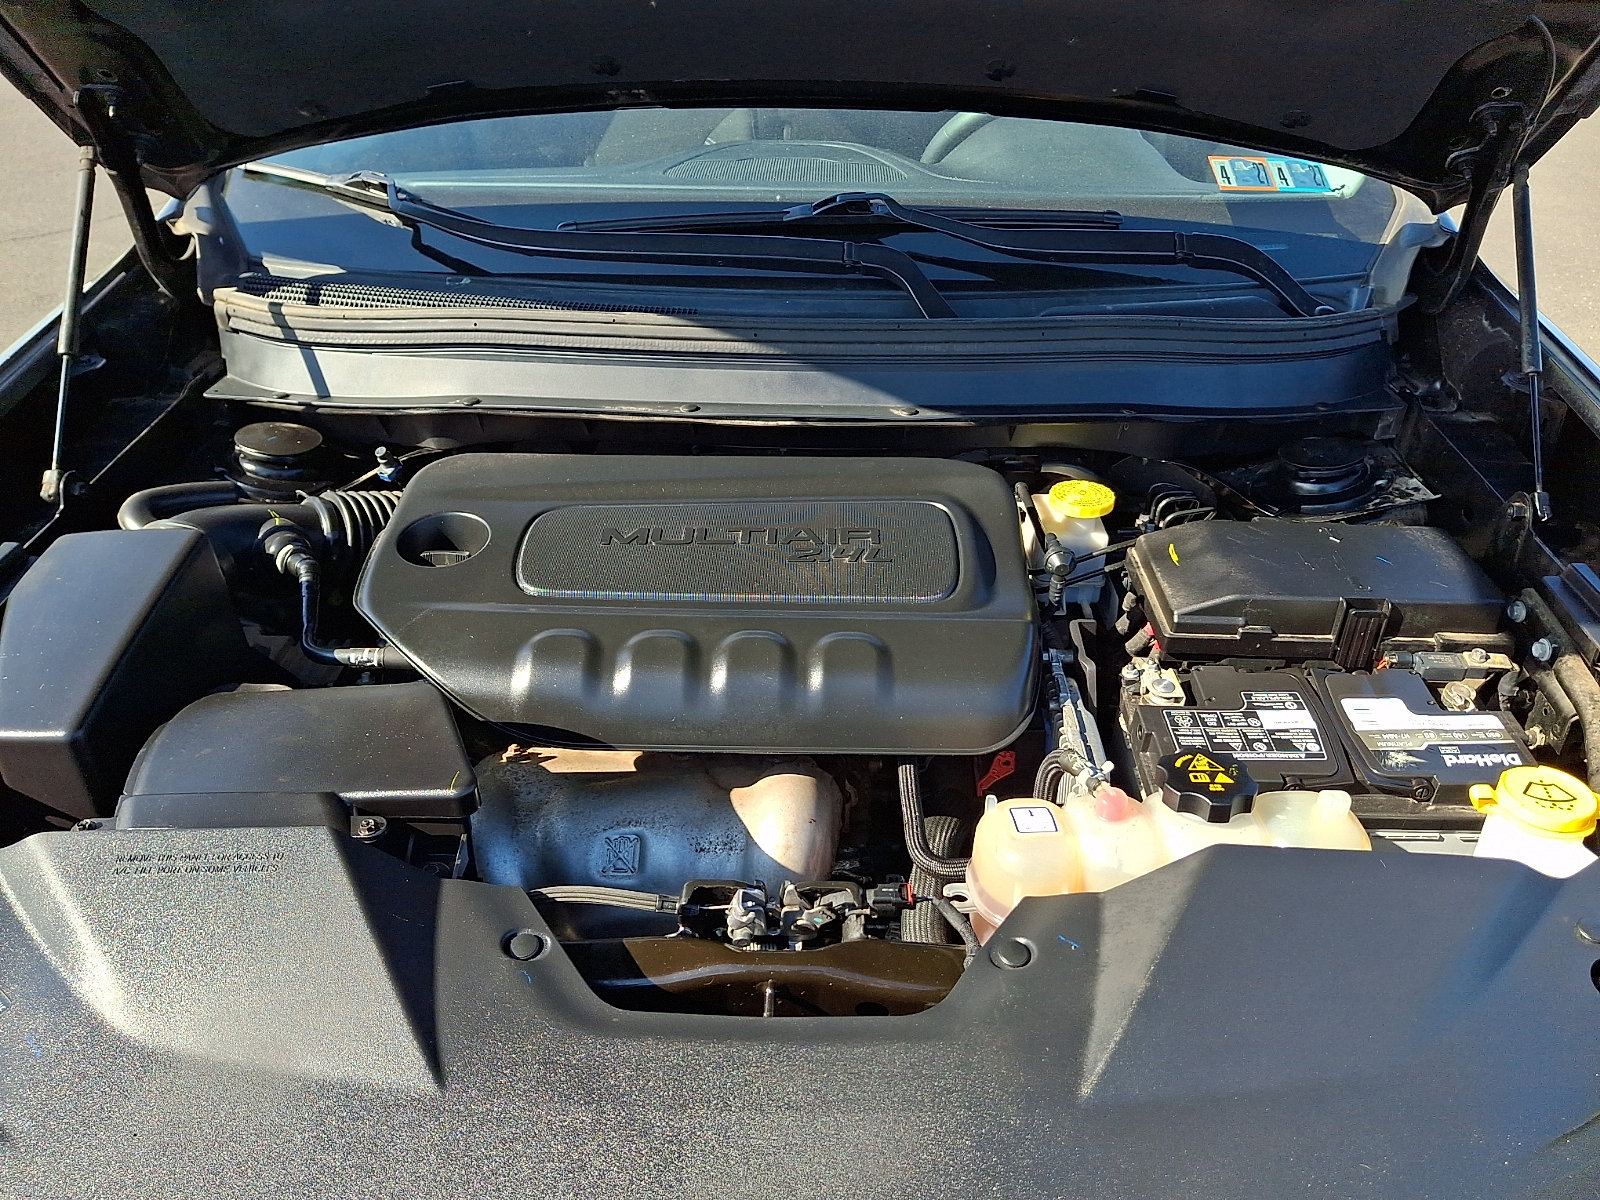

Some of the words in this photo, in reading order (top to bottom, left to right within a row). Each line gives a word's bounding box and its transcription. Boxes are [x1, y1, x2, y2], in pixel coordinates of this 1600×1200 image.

[1219, 165, 1231, 185] 4
[1252, 162, 1271, 187] 27
[1277, 167, 1290, 187] 4
[600, 526, 882, 547] MULTIAIR
[786, 546, 894, 564] 2.4L
[1443, 753, 1523, 767] DieHard
[115, 853, 153, 863] REMOVE
[157, 853, 179, 862] THIS
[179, 853, 209, 862] PANEL
[211, 853, 232, 861] FOR
[232, 852, 270, 861] ACCESS
[272, 851, 285, 861] TO
[112, 866, 131, 875] A/C
[157, 865, 183, 874] PORT
[185, 865, 201, 874] ON
[200, 864, 231, 873] SOME
[233, 864, 280, 873] VEHICLES
